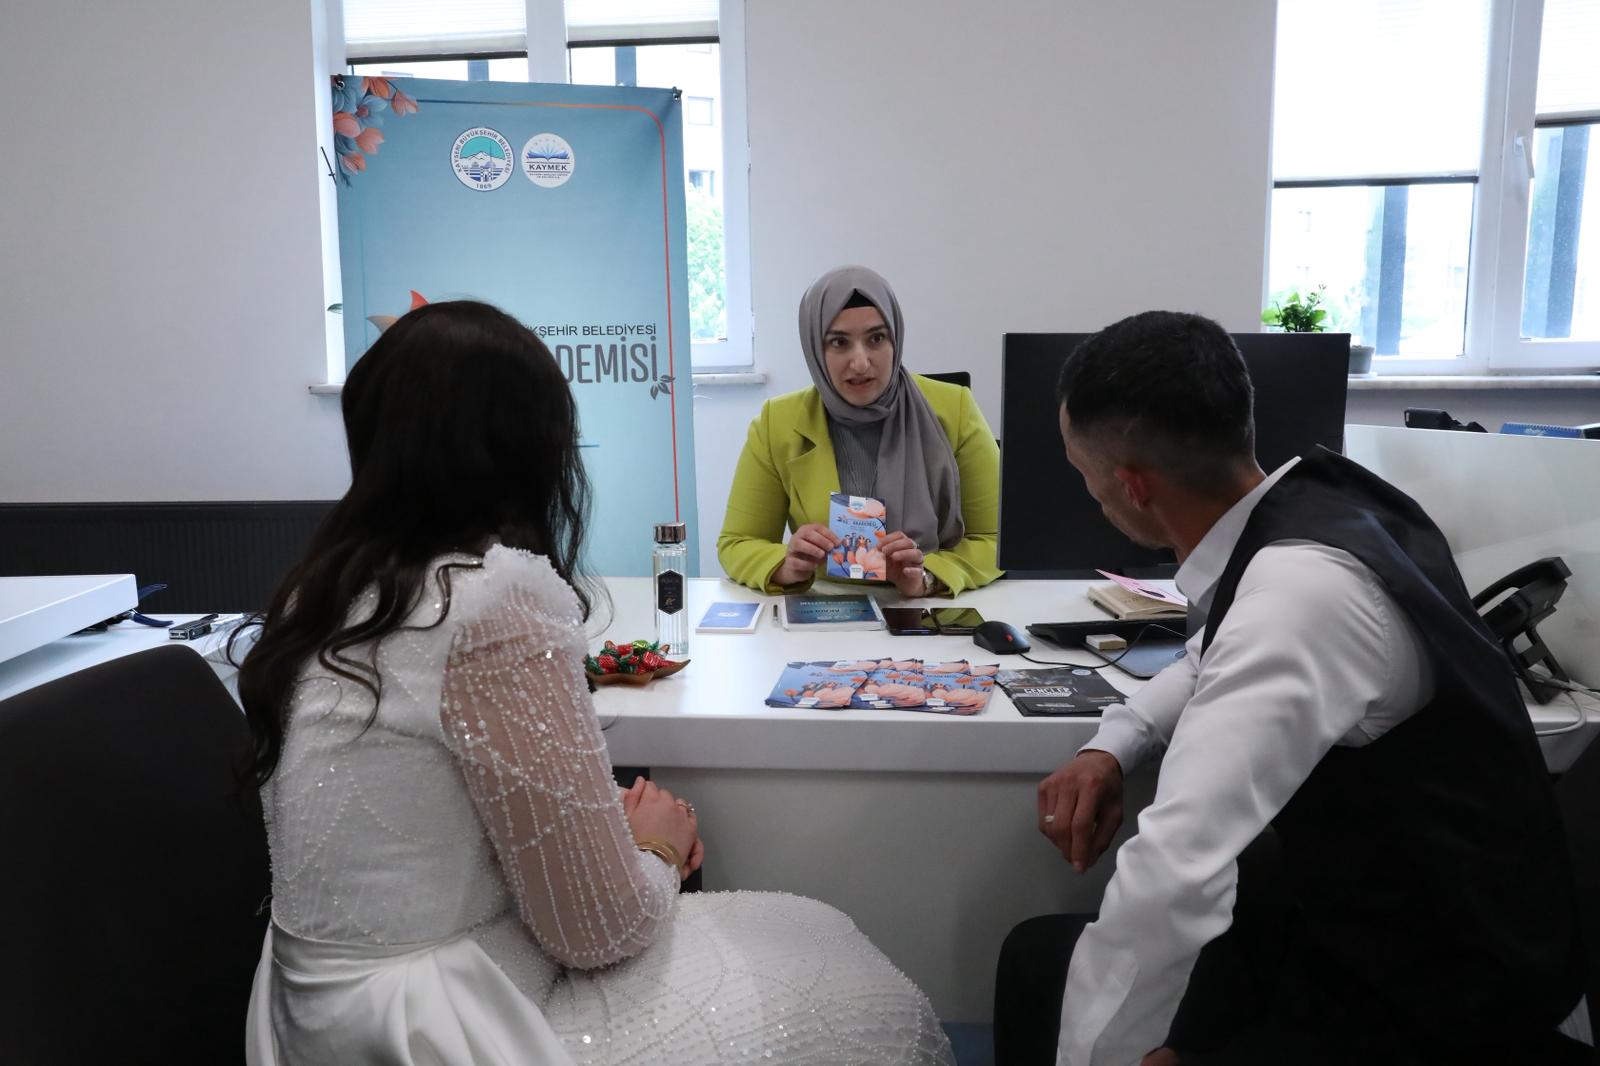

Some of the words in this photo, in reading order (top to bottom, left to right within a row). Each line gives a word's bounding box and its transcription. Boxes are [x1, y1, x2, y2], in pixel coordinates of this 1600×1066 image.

[525, 324, 578, 338] KŞEHİR
[582, 323, 657, 336] BELEDİYESİ
[555, 336, 658, 384] DEMİSİ
